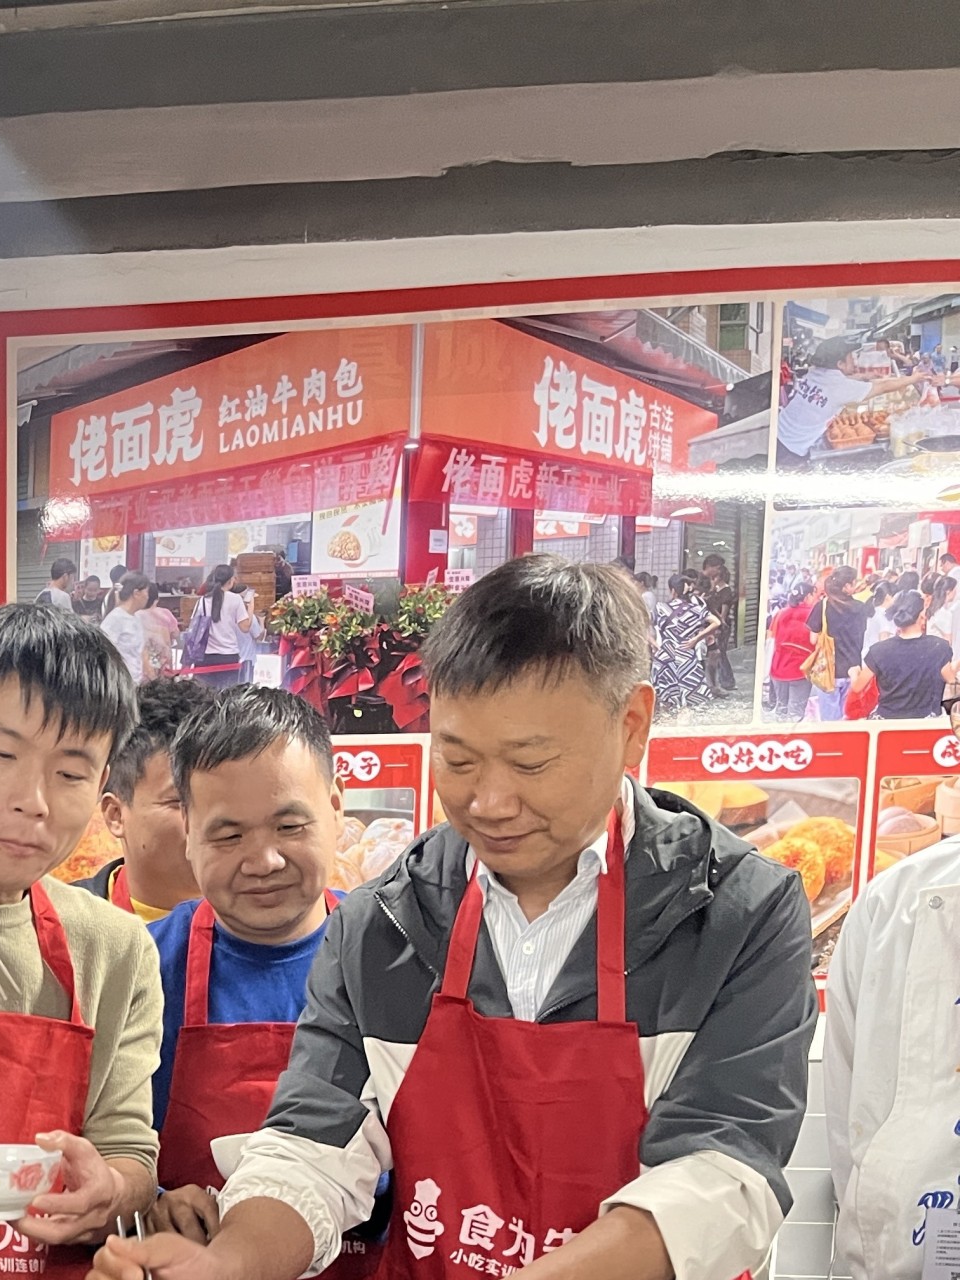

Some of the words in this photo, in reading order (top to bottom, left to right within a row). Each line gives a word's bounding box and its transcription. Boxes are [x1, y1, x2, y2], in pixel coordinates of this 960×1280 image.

[218, 357, 364, 429] 红油牛肉包
[219, 400, 363, 454] LAOMIANHU
[532, 355, 647, 466] 佬面虎
[68, 385, 205, 487] 佬面虎
[709, 745, 808, 768] 油炸小吃
